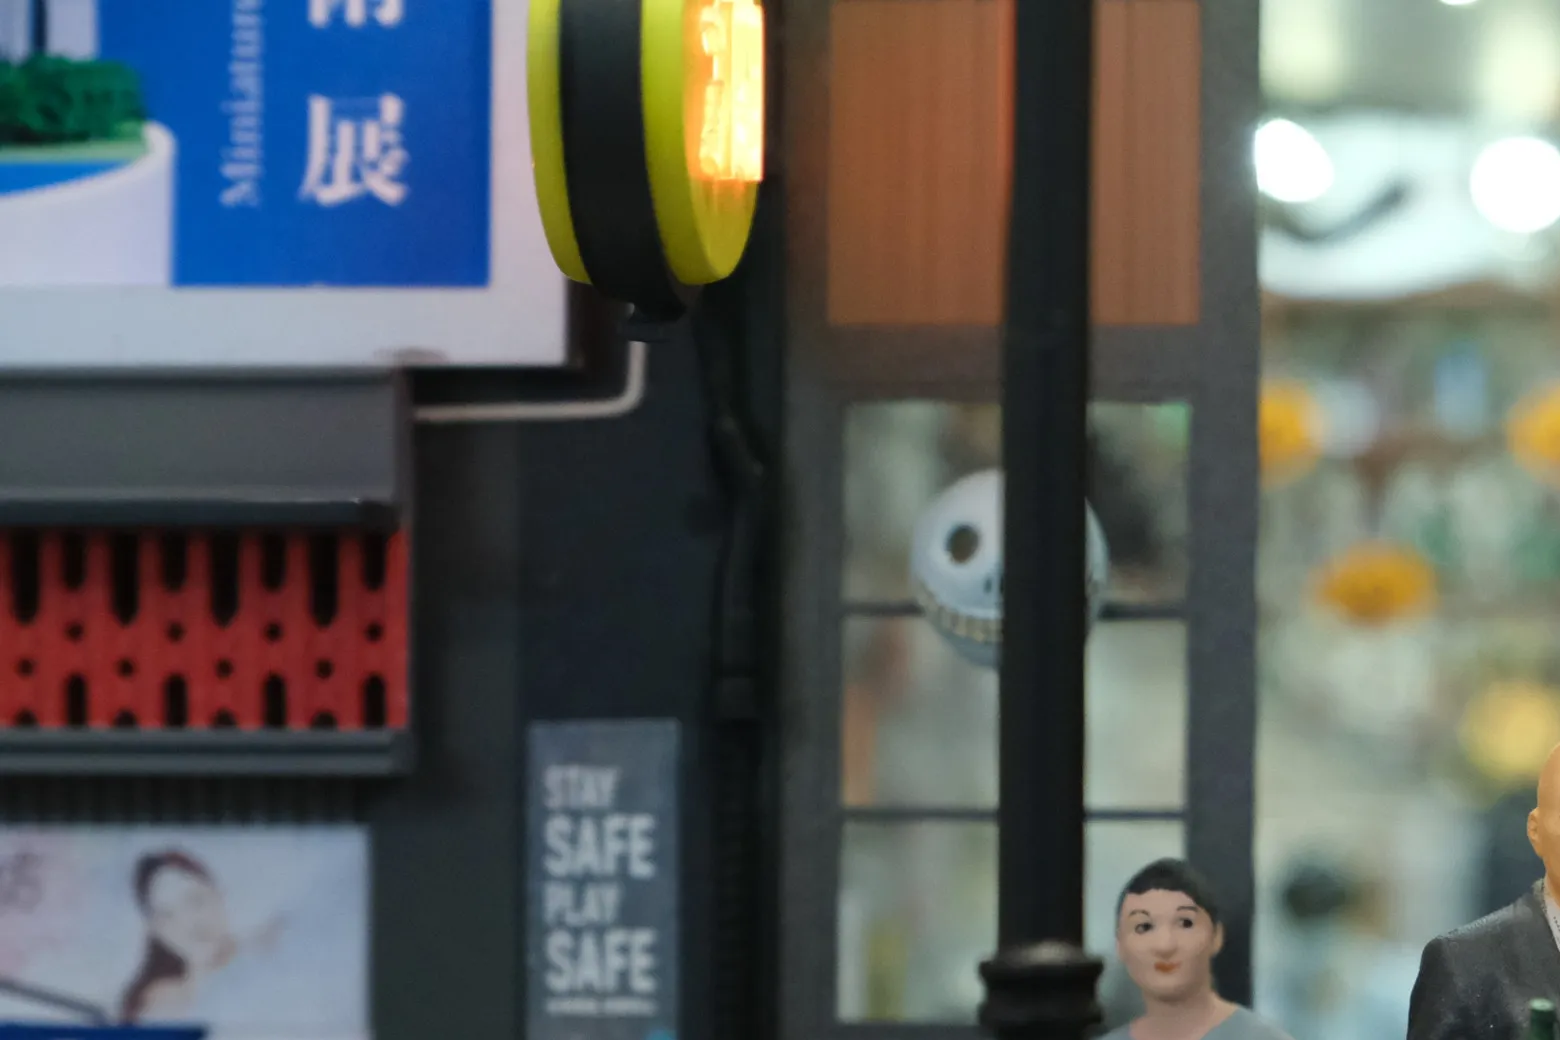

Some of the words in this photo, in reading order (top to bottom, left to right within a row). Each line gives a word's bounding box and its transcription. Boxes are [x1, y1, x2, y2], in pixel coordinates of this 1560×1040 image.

[545, 812, 656, 879] SAFE
[544, 882, 622, 926] PLAY
[545, 927, 657, 994] SAFE
